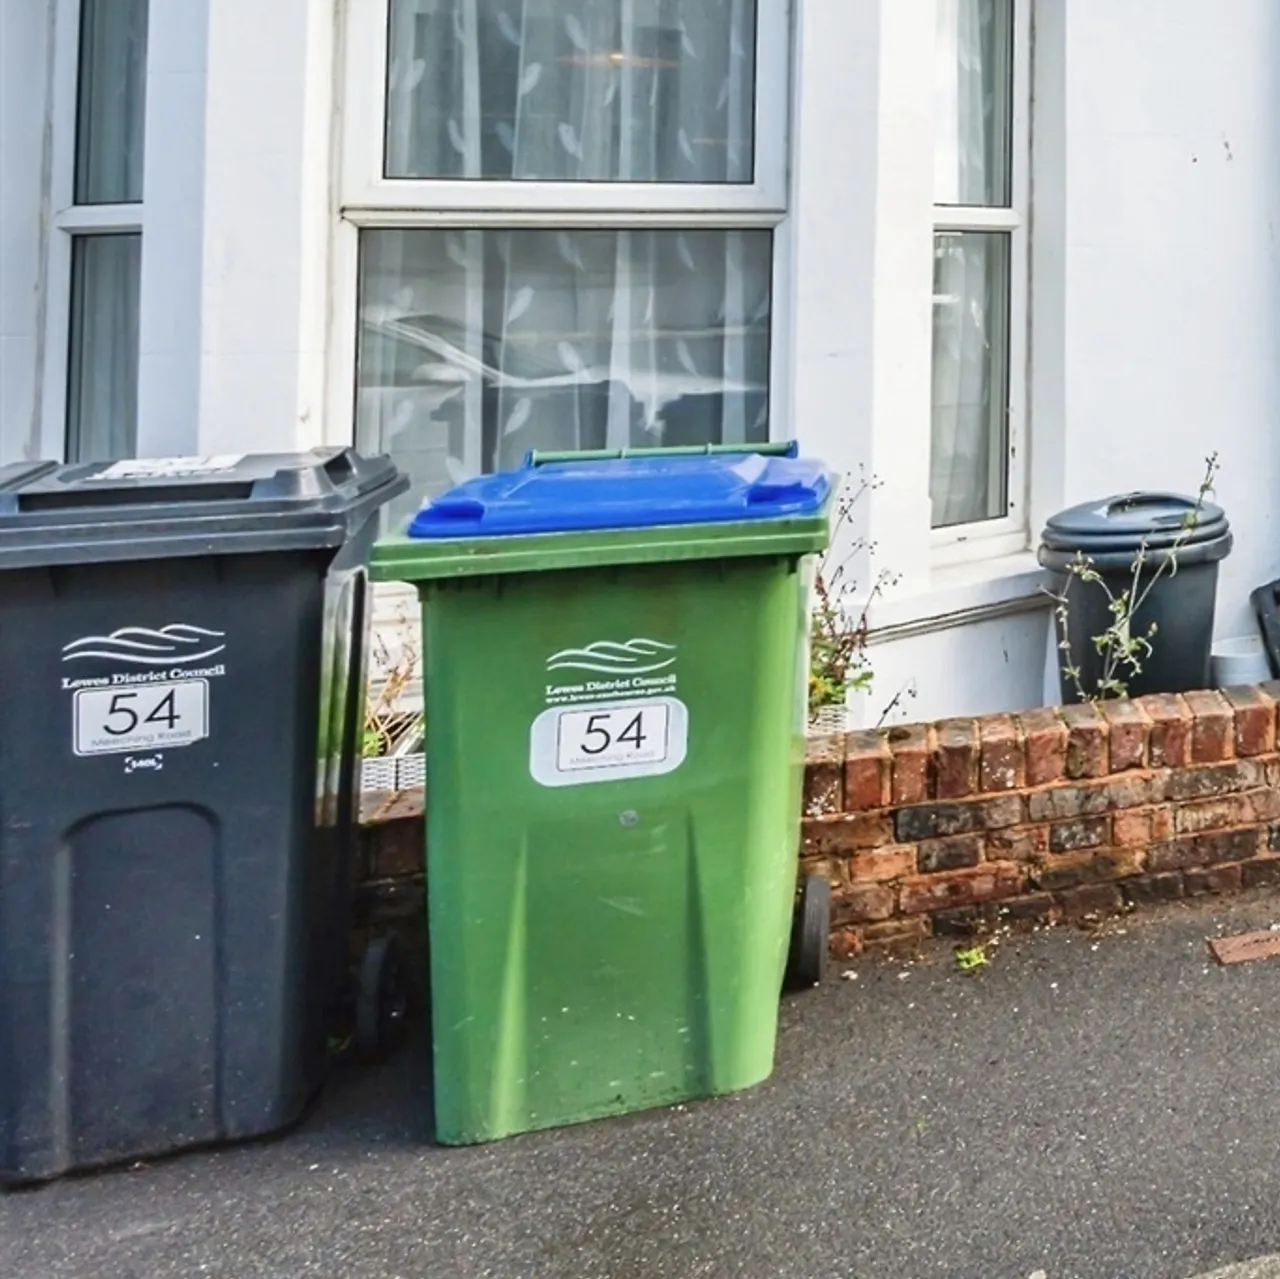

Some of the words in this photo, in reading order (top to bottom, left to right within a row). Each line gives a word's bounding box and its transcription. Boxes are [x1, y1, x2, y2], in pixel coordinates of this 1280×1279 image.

[61, 677, 109, 689] Lewes
[112, 670, 167, 685] District
[170, 664, 226, 679] Council
[586, 679, 630, 691] District
[632, 674, 676, 687] Council
[103, 688, 181, 735] 54
[580, 711, 647, 754] 54
